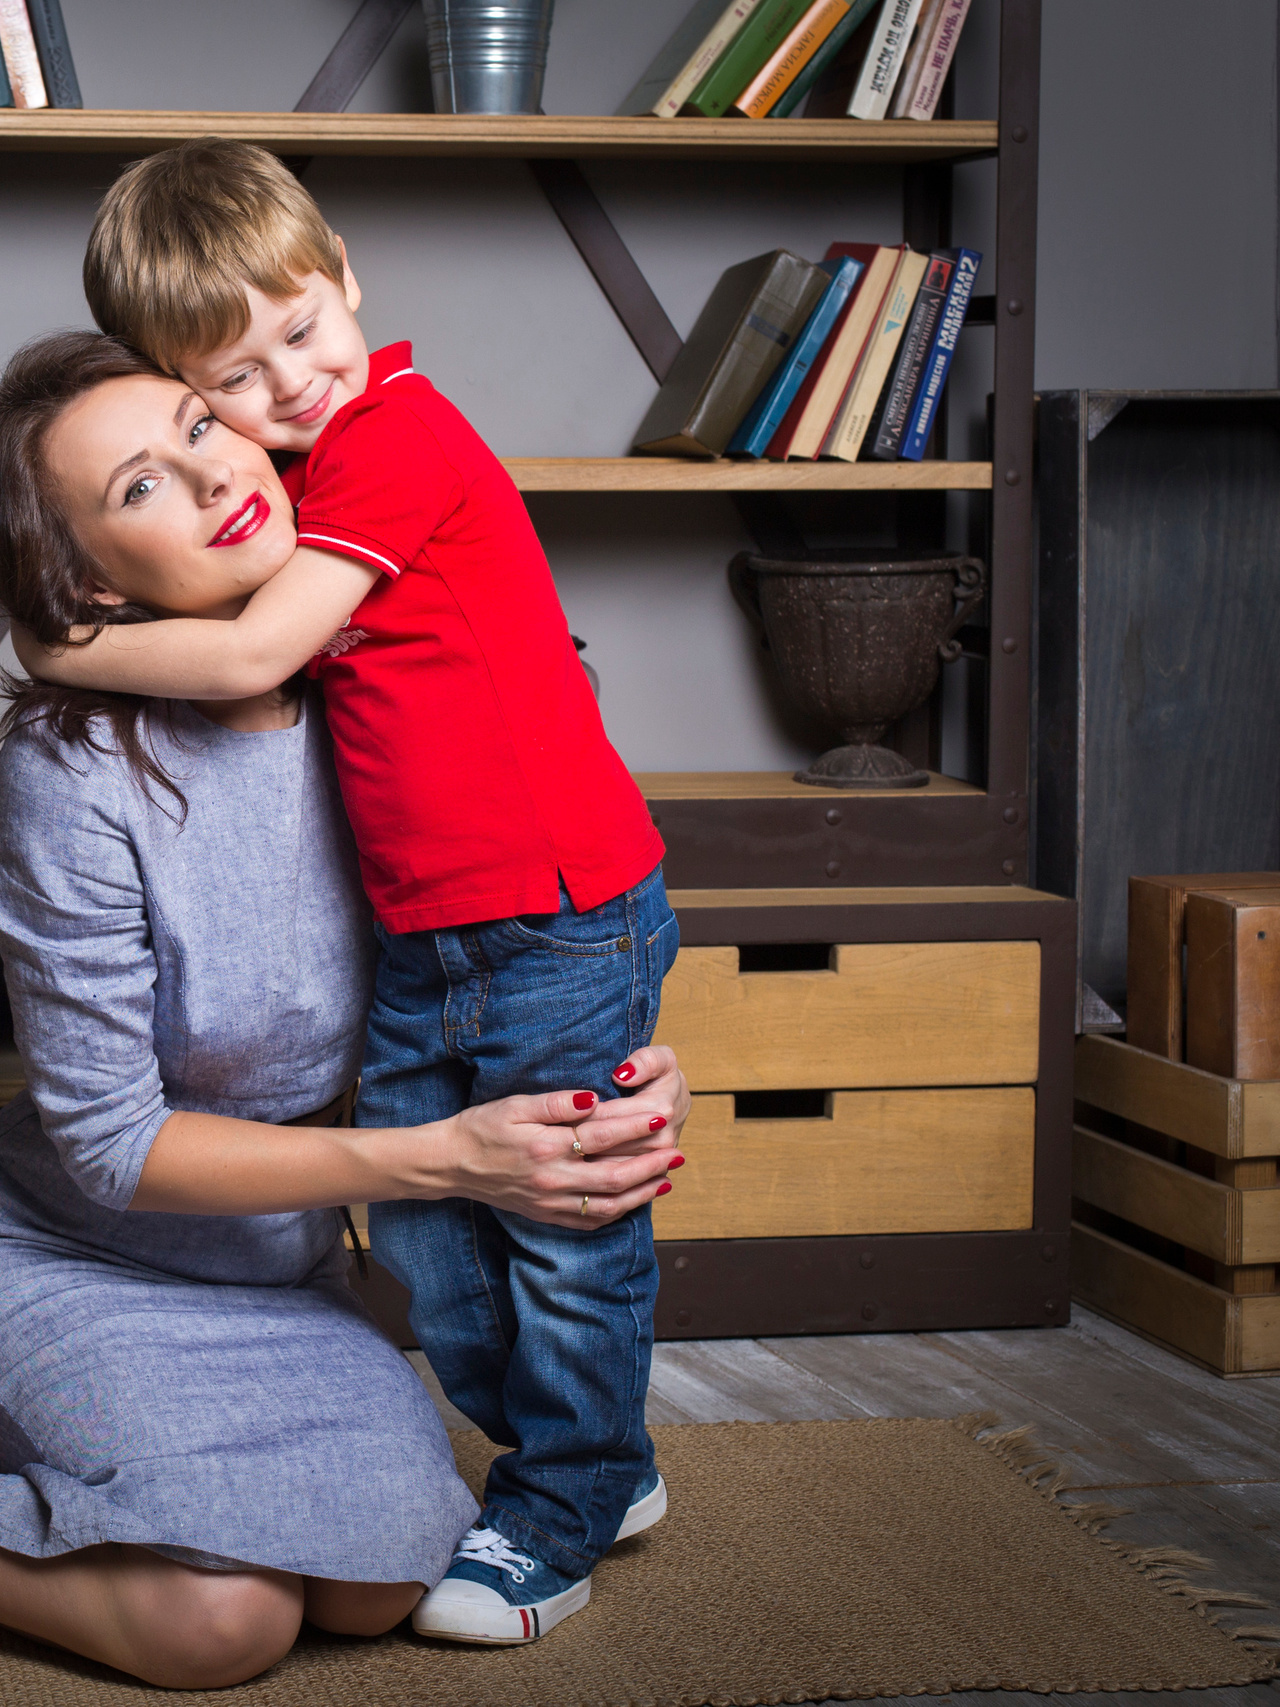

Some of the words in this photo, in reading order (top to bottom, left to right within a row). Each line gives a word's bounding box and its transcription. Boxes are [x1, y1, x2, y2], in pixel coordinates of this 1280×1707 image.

[781, 30, 815, 72] ГАРСИА
[885, 30, 900, 45] по
[931, 52, 946, 69] НЕ
[751, 70, 785, 114] МАРКЕС
[913, 302, 927, 335] ЛЮБВИ
[937, 271, 966, 348] МОСКВА
[960, 256, 979, 274] 2
[945, 273, 975, 351] БАНДИТСКАЯ
[891, 365, 920, 437] АЛЕКСАНДРА
[914, 298, 940, 363] МАРИНИНА
[899, 336, 916, 380] НЕМНОГО
[896, 381, 904, 390] И
[916, 397, 934, 434] НИКОЛАЙ
[927, 354, 947, 397] МОДЕСТОВ
[886, 390, 901, 425] СМЕРТЬ
